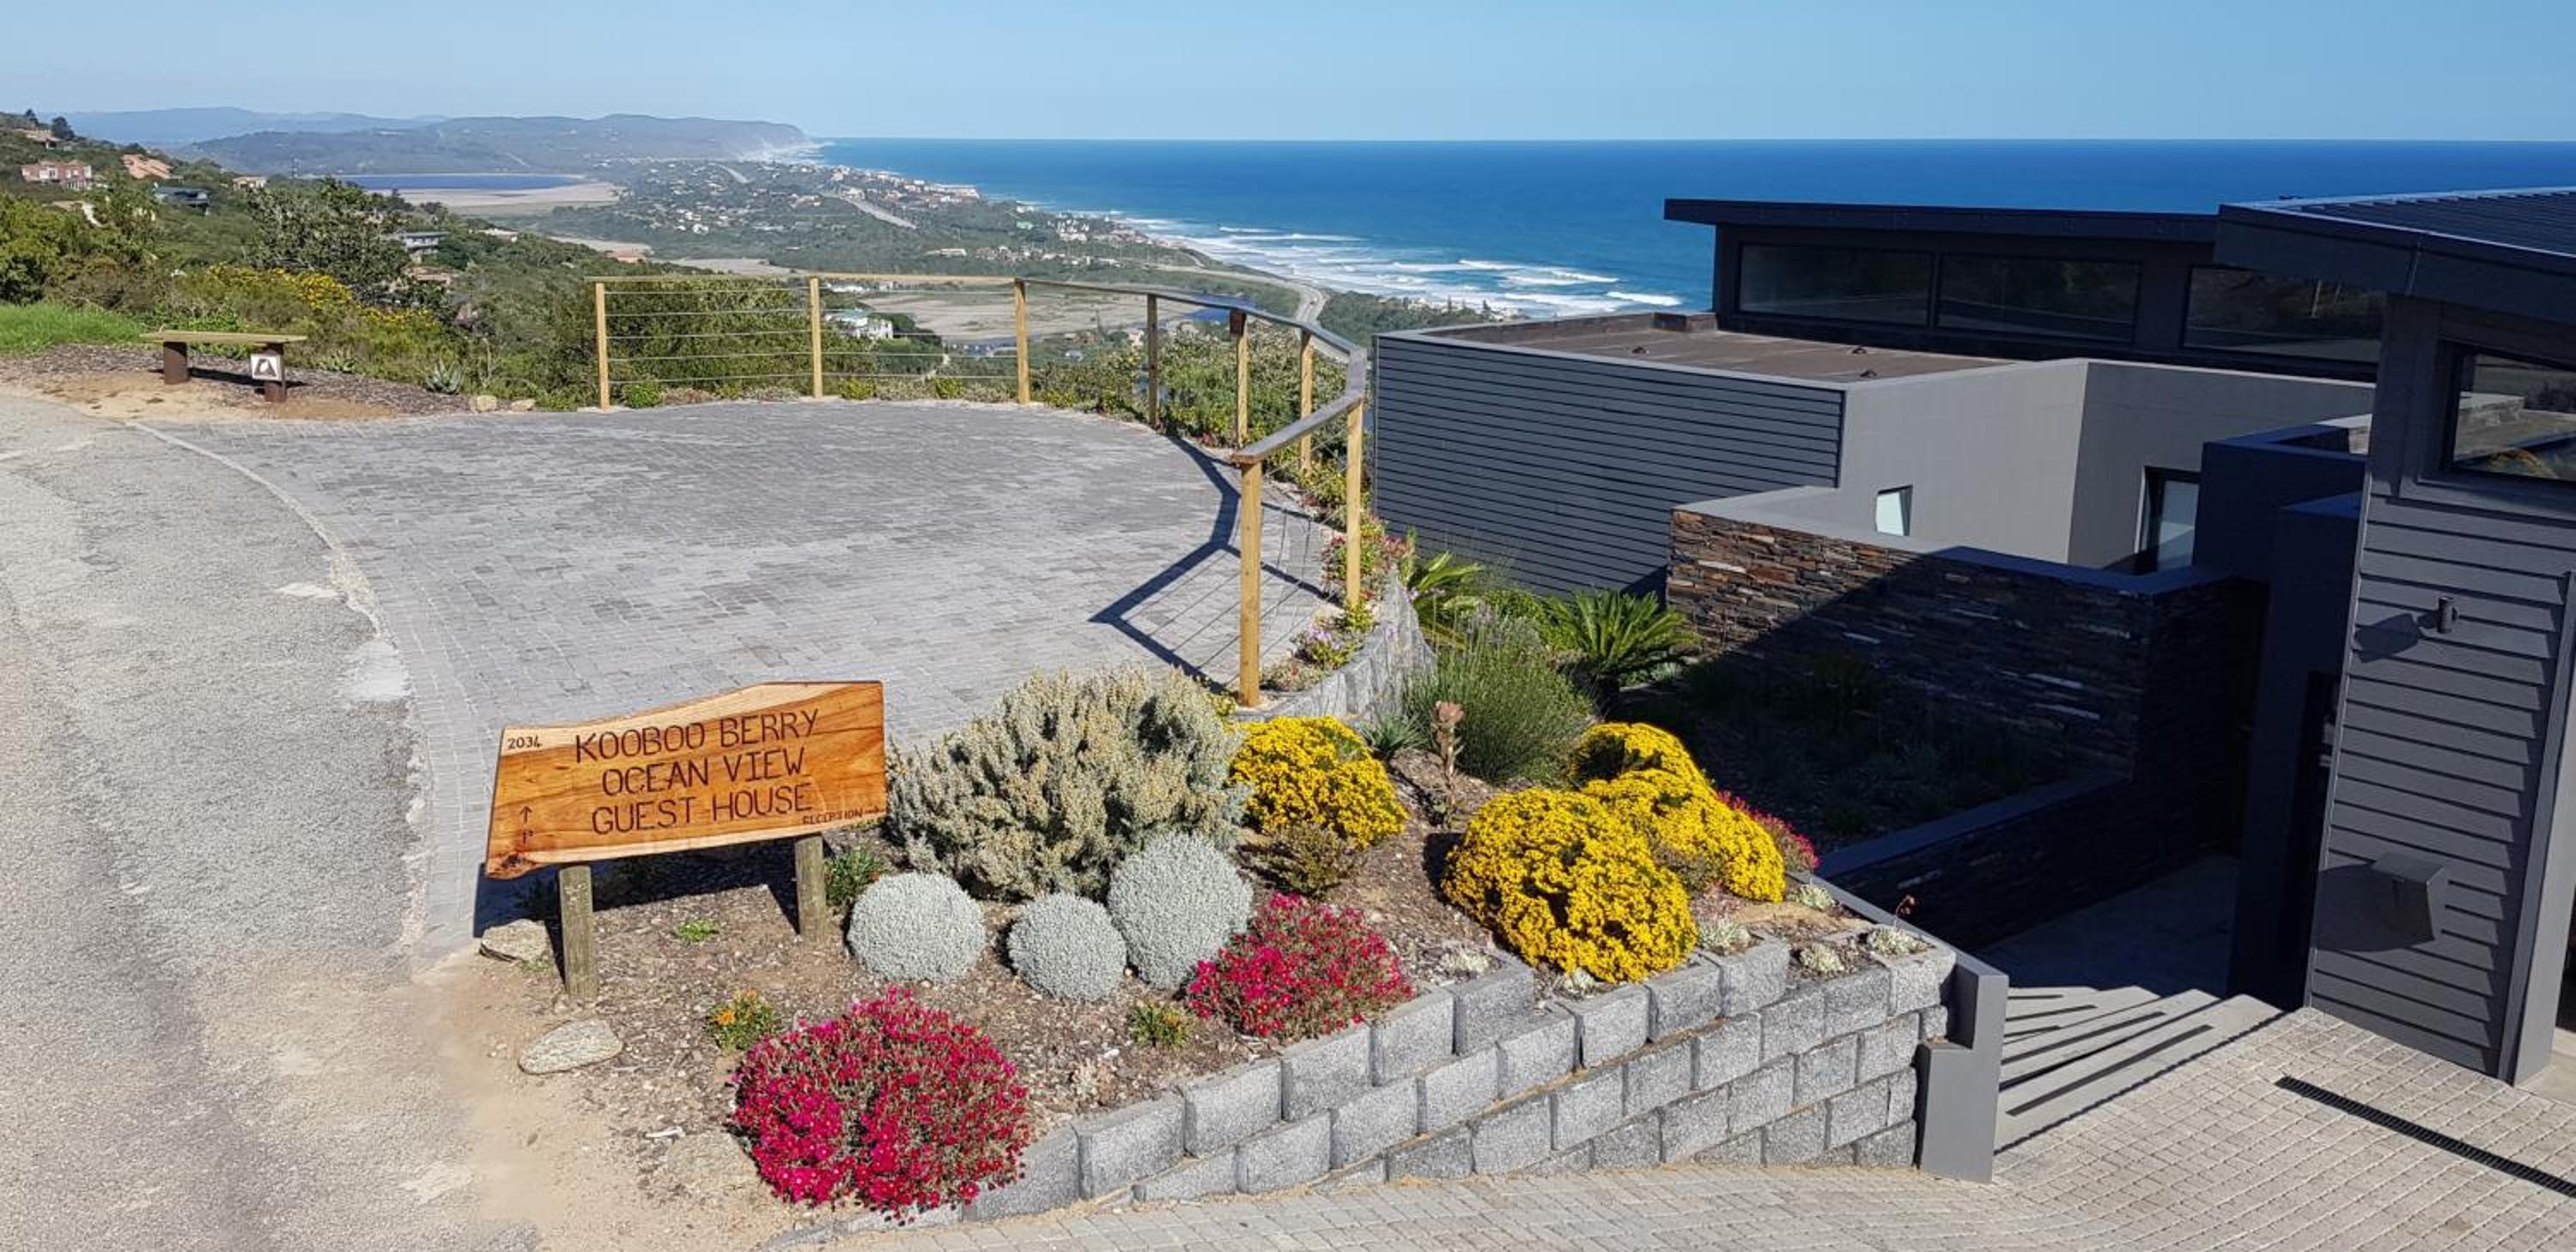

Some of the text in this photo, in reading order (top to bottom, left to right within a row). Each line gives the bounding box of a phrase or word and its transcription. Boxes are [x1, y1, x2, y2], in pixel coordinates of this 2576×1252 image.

[507, 737, 542, 750] 2034
[575, 709, 819, 763] KOOBOO BERRY
[602, 747, 804, 796] OCEAN VIEW
[592, 783, 812, 835] GUEST HOUSE
[802, 808, 863, 825] RECEPTION
